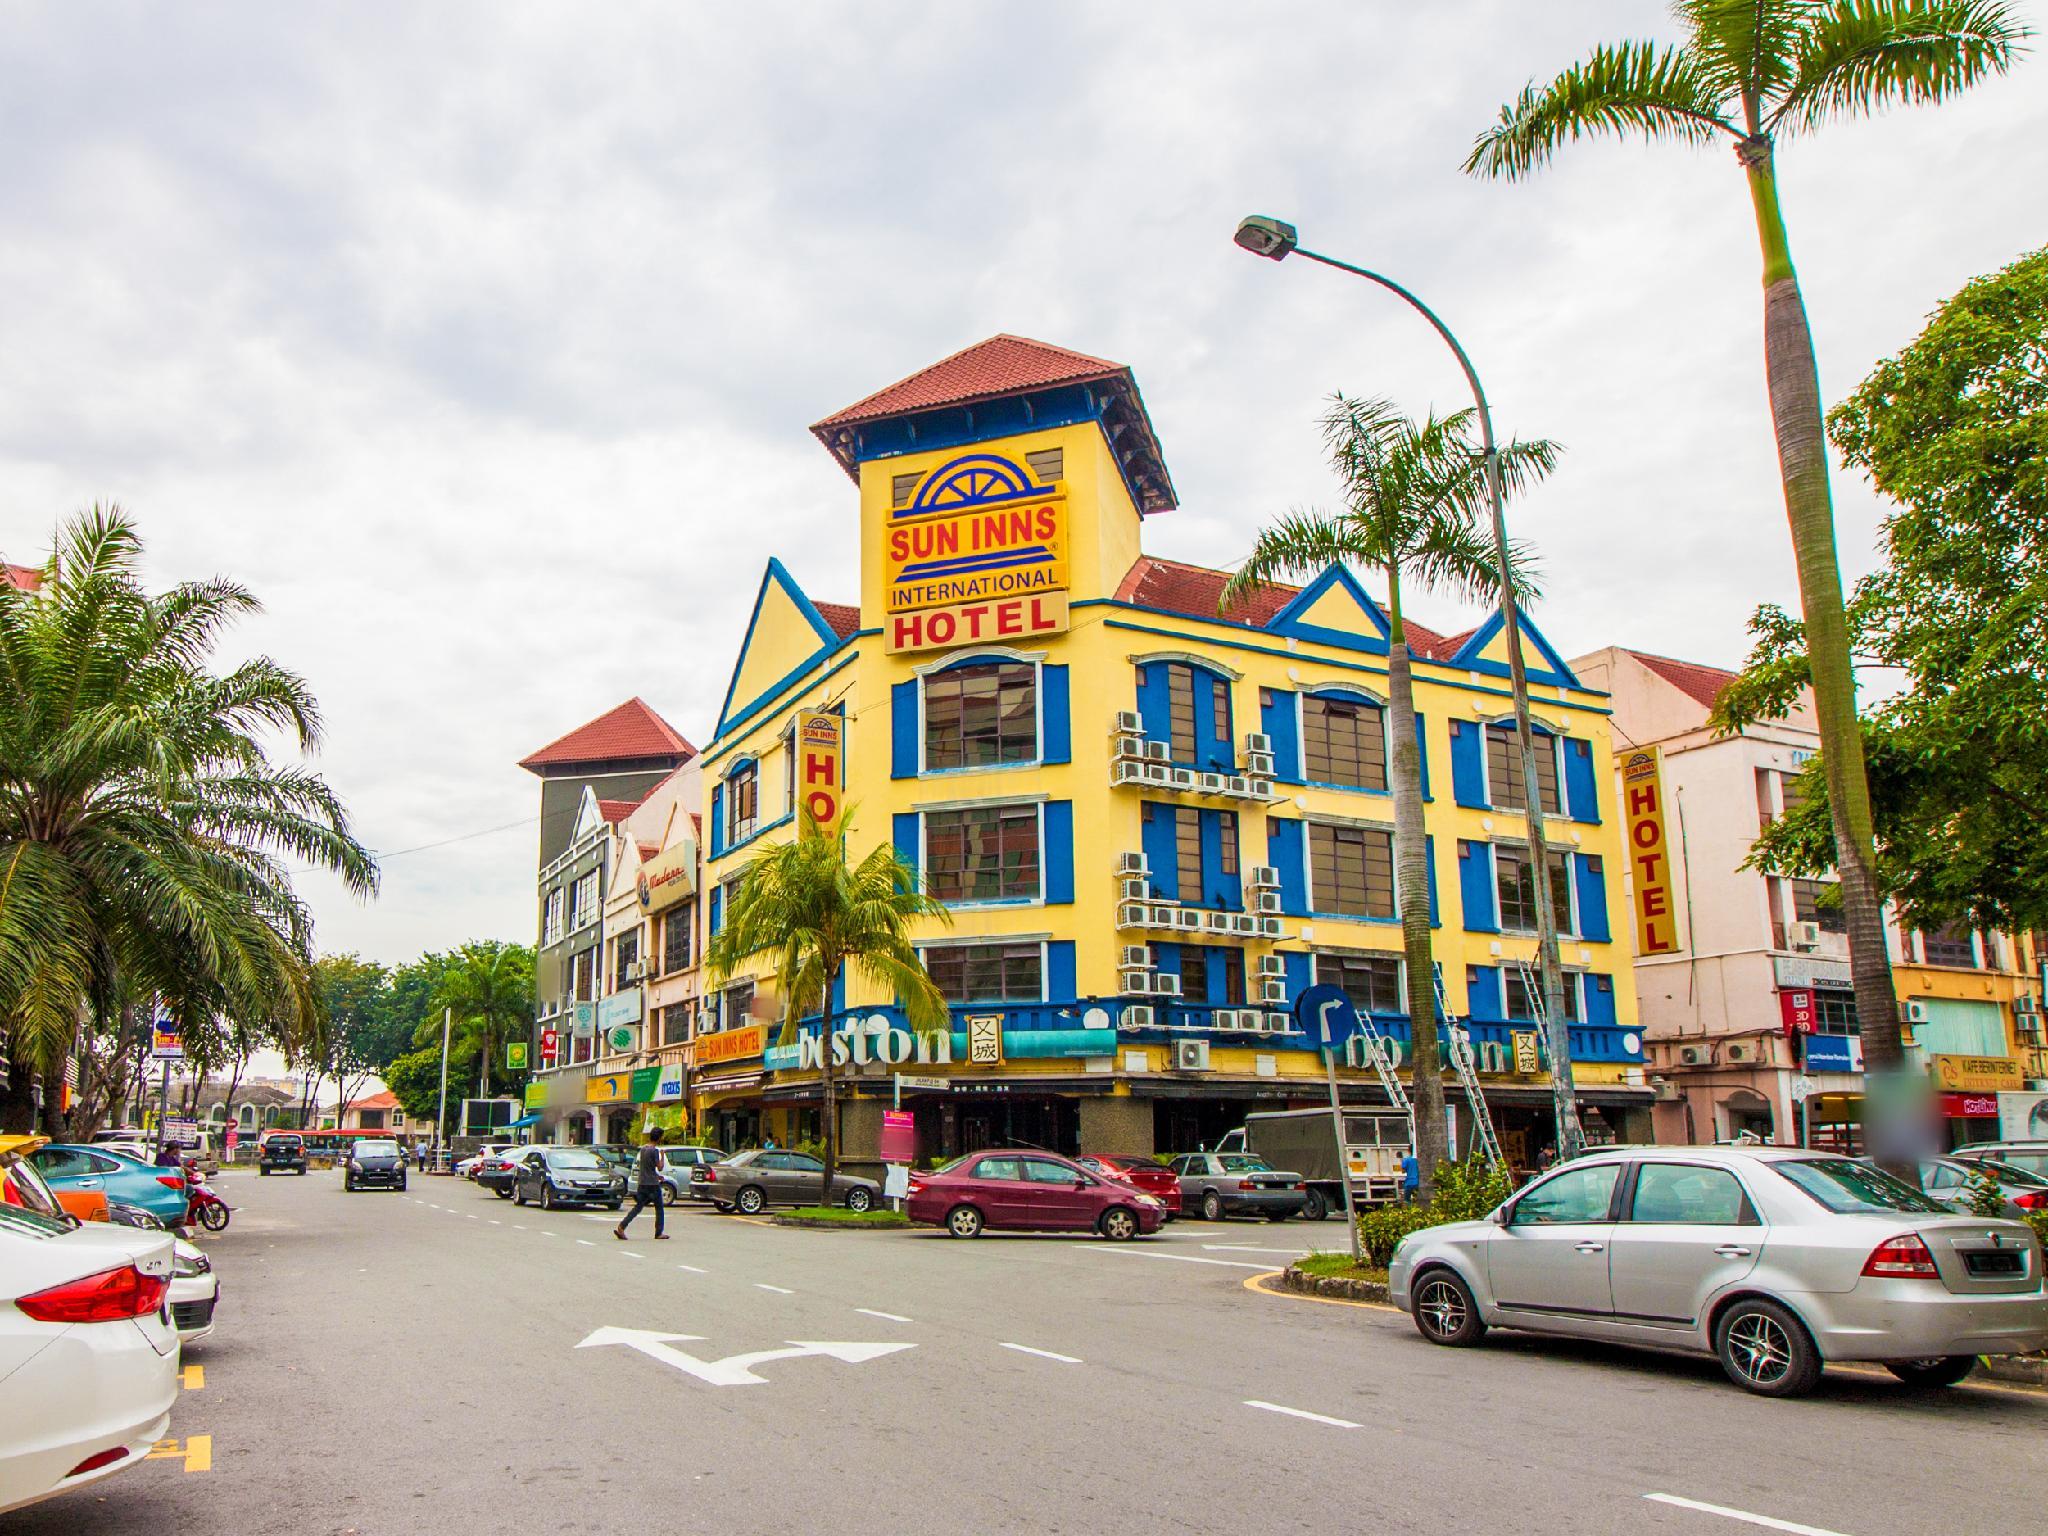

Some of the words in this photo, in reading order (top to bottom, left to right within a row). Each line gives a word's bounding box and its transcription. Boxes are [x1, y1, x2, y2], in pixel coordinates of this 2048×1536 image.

[890, 522, 959, 562] SUN
[972, 506, 1057, 550] INNS
[892, 568, 1059, 606] INTERNATIONAL
[894, 598, 1057, 649] HOTEL
[803, 728, 818, 738] SUN
[820, 729, 837, 740] INNS
[1625, 766, 1638, 776] SUN
[1638, 763, 1655, 774] INNS
[1630, 784, 1669, 951] HOTEL
[709, 1038, 721, 1058] SUN
[722, 1034, 737, 1056] INNS
[739, 1031, 760, 1053] HOTEL
[973, 1020, 996, 1059] 又一城
[1518, 1035, 1536, 1071] 又一城
